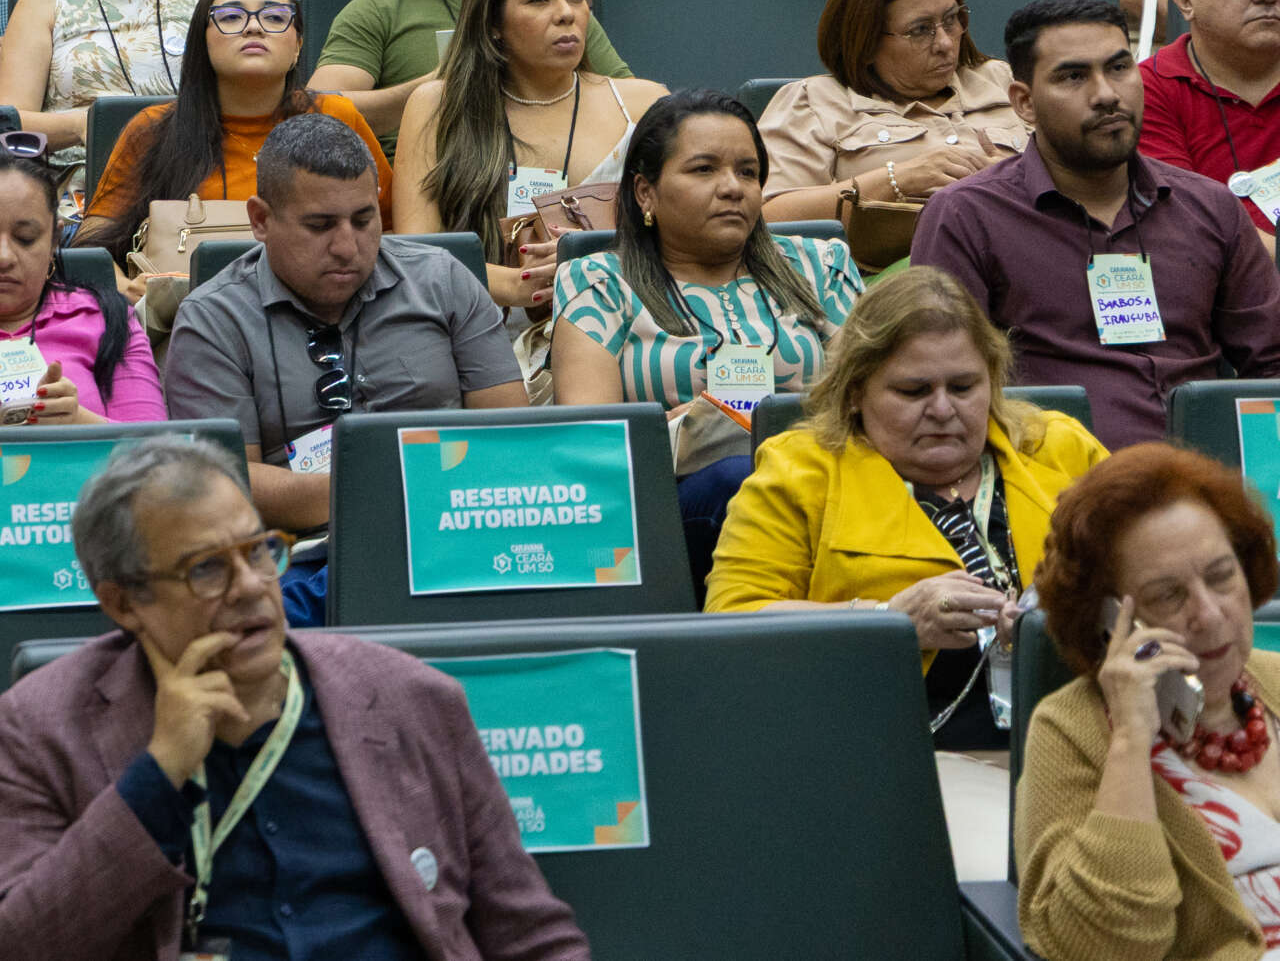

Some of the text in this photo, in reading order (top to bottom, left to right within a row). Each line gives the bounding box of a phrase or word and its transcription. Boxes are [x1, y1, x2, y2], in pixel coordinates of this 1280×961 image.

[0, 375, 30, 393] JOSY
[450, 483, 587, 508] RESERVADO
[438, 504, 602, 531] AUTORIDADES
[515, 551, 553, 564] CEARÁ
[517, 564, 536, 573] UM
